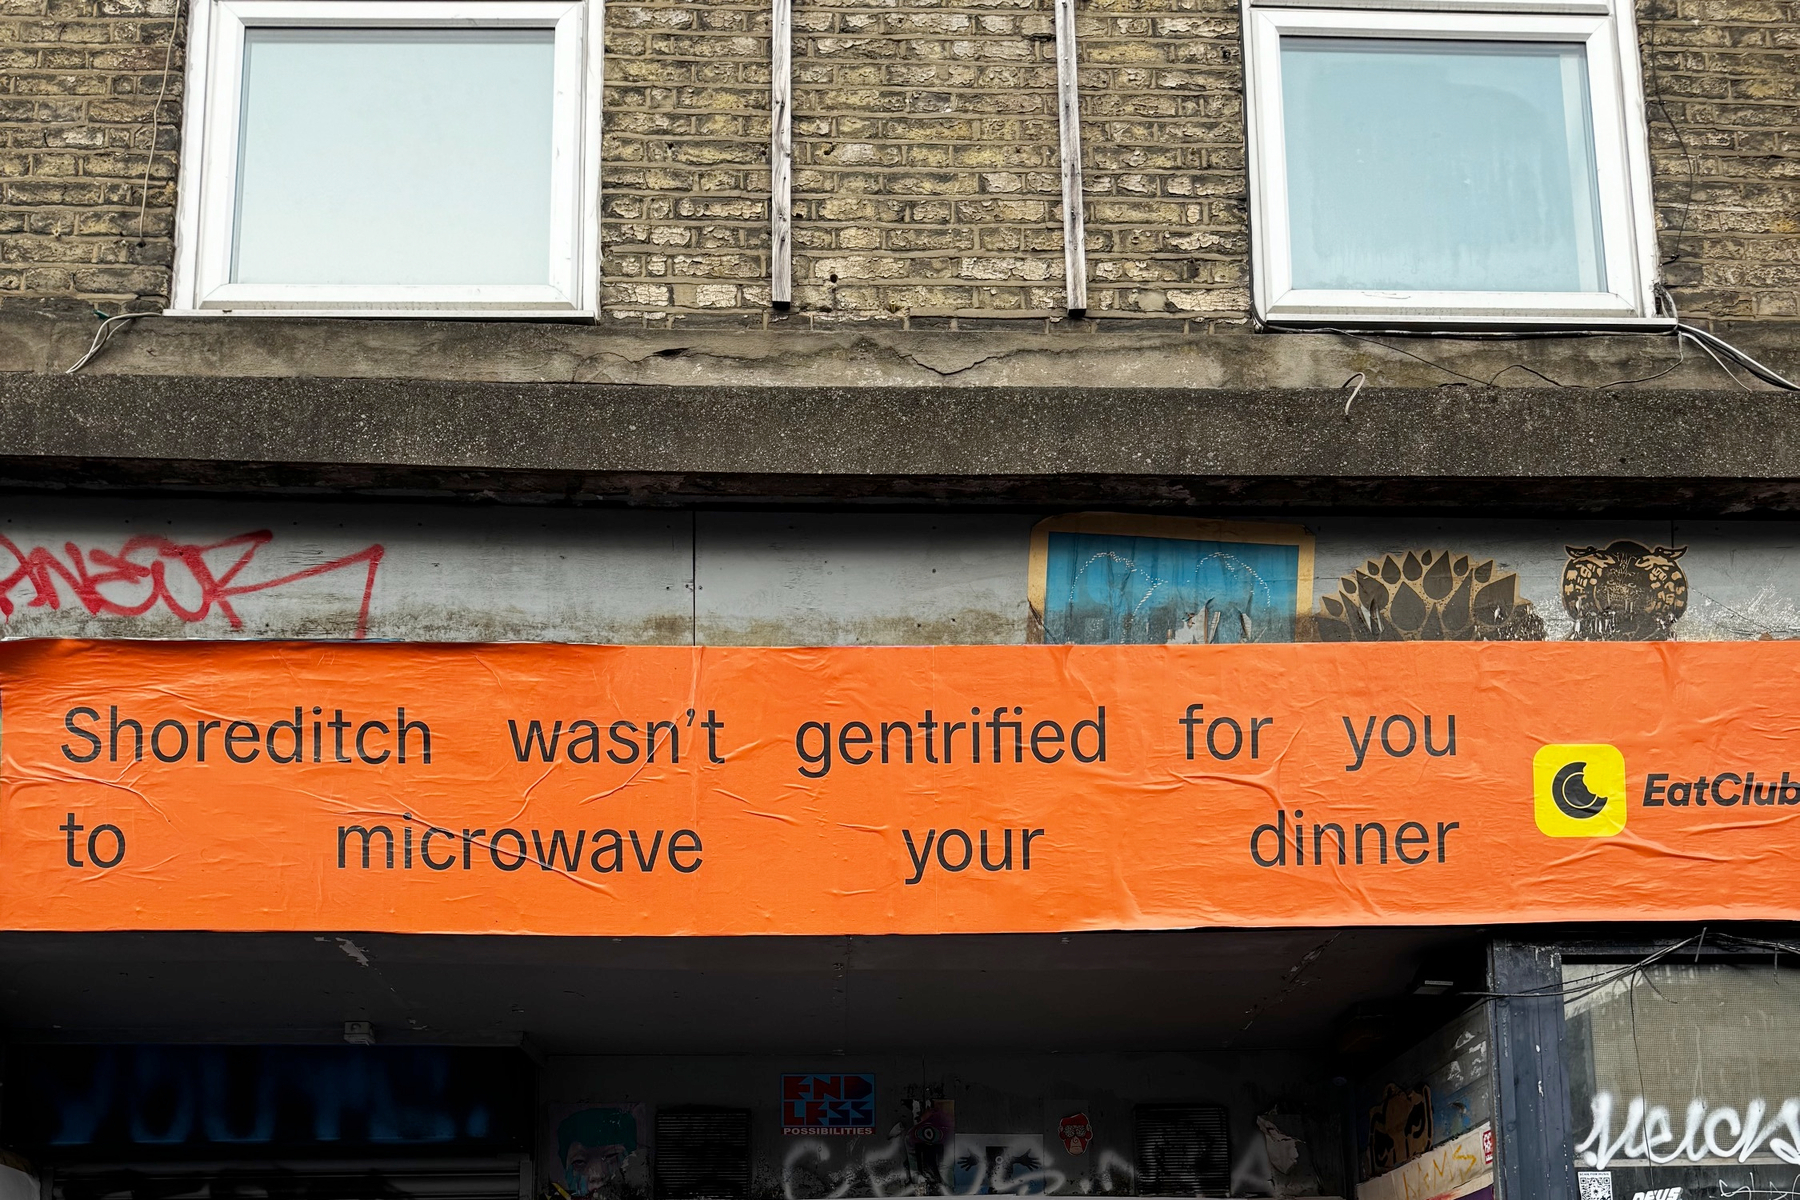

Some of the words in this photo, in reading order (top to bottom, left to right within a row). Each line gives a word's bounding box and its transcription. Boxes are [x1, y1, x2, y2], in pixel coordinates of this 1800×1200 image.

[60, 705, 431, 765] Shoreditch
[508, 708, 726, 766] wasn’t
[796, 705, 1106, 779] gentrified
[1179, 703, 1274, 761] for
[1343, 714, 1457, 772] you
[1643, 771, 1800, 806] EatClub
[59, 812, 126, 869] to
[338, 813, 703, 874] microwave
[902, 828, 1045, 885] your
[1251, 809, 1460, 868] dinner
